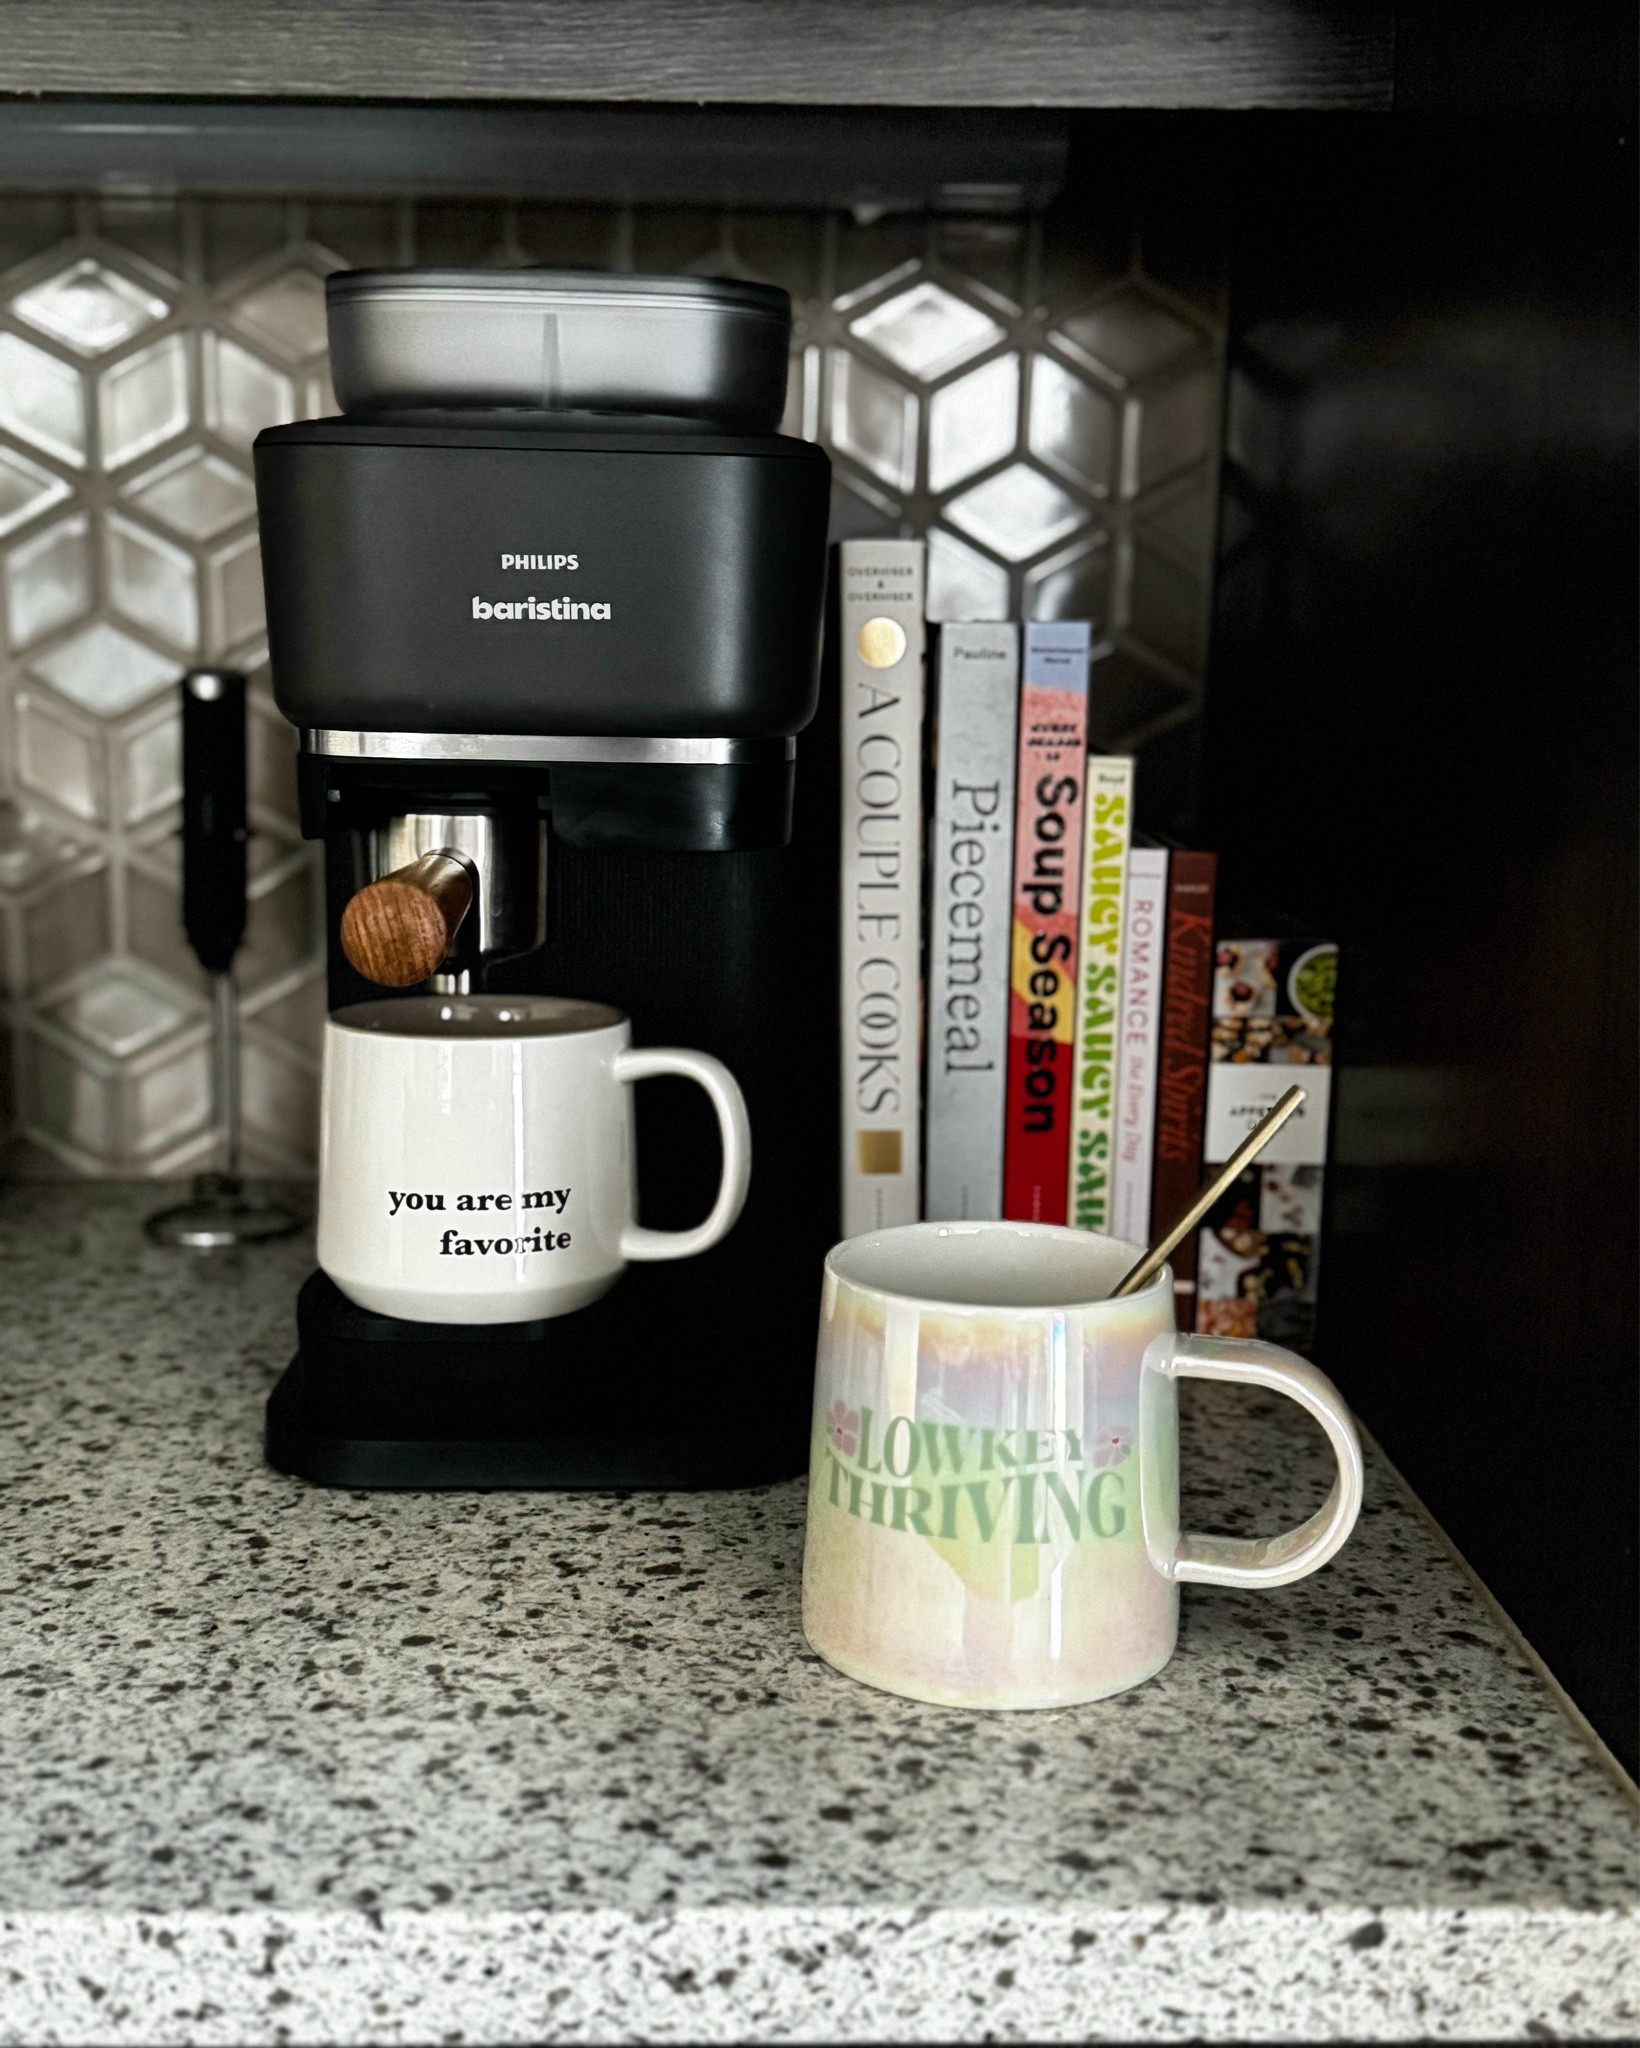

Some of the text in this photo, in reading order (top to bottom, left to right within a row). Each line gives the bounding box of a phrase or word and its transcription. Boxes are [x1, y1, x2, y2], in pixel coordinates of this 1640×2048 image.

[472, 595, 611, 621] baristina
[501, 553, 579, 570] PHILIPS
[953, 646, 1007, 661] Pauline
[856, 682, 902, 1114] A COUPLE COOKS
[1021, 774, 1079, 917] Soup
[1088, 792, 1126, 954] SAUCY
[944, 779, 1001, 1075] Piecemeal
[1125, 898, 1154, 1047] ROMANCE
[1163, 910, 1212, 1059] Kindred
[1022, 931, 1071, 1133] Season
[1080, 962, 1117, 1121] SAUCY
[388, 1188, 572, 1216] you are my
[439, 1226, 572, 1256] favorite
[824, 1446, 1128, 1545] THRIVING
